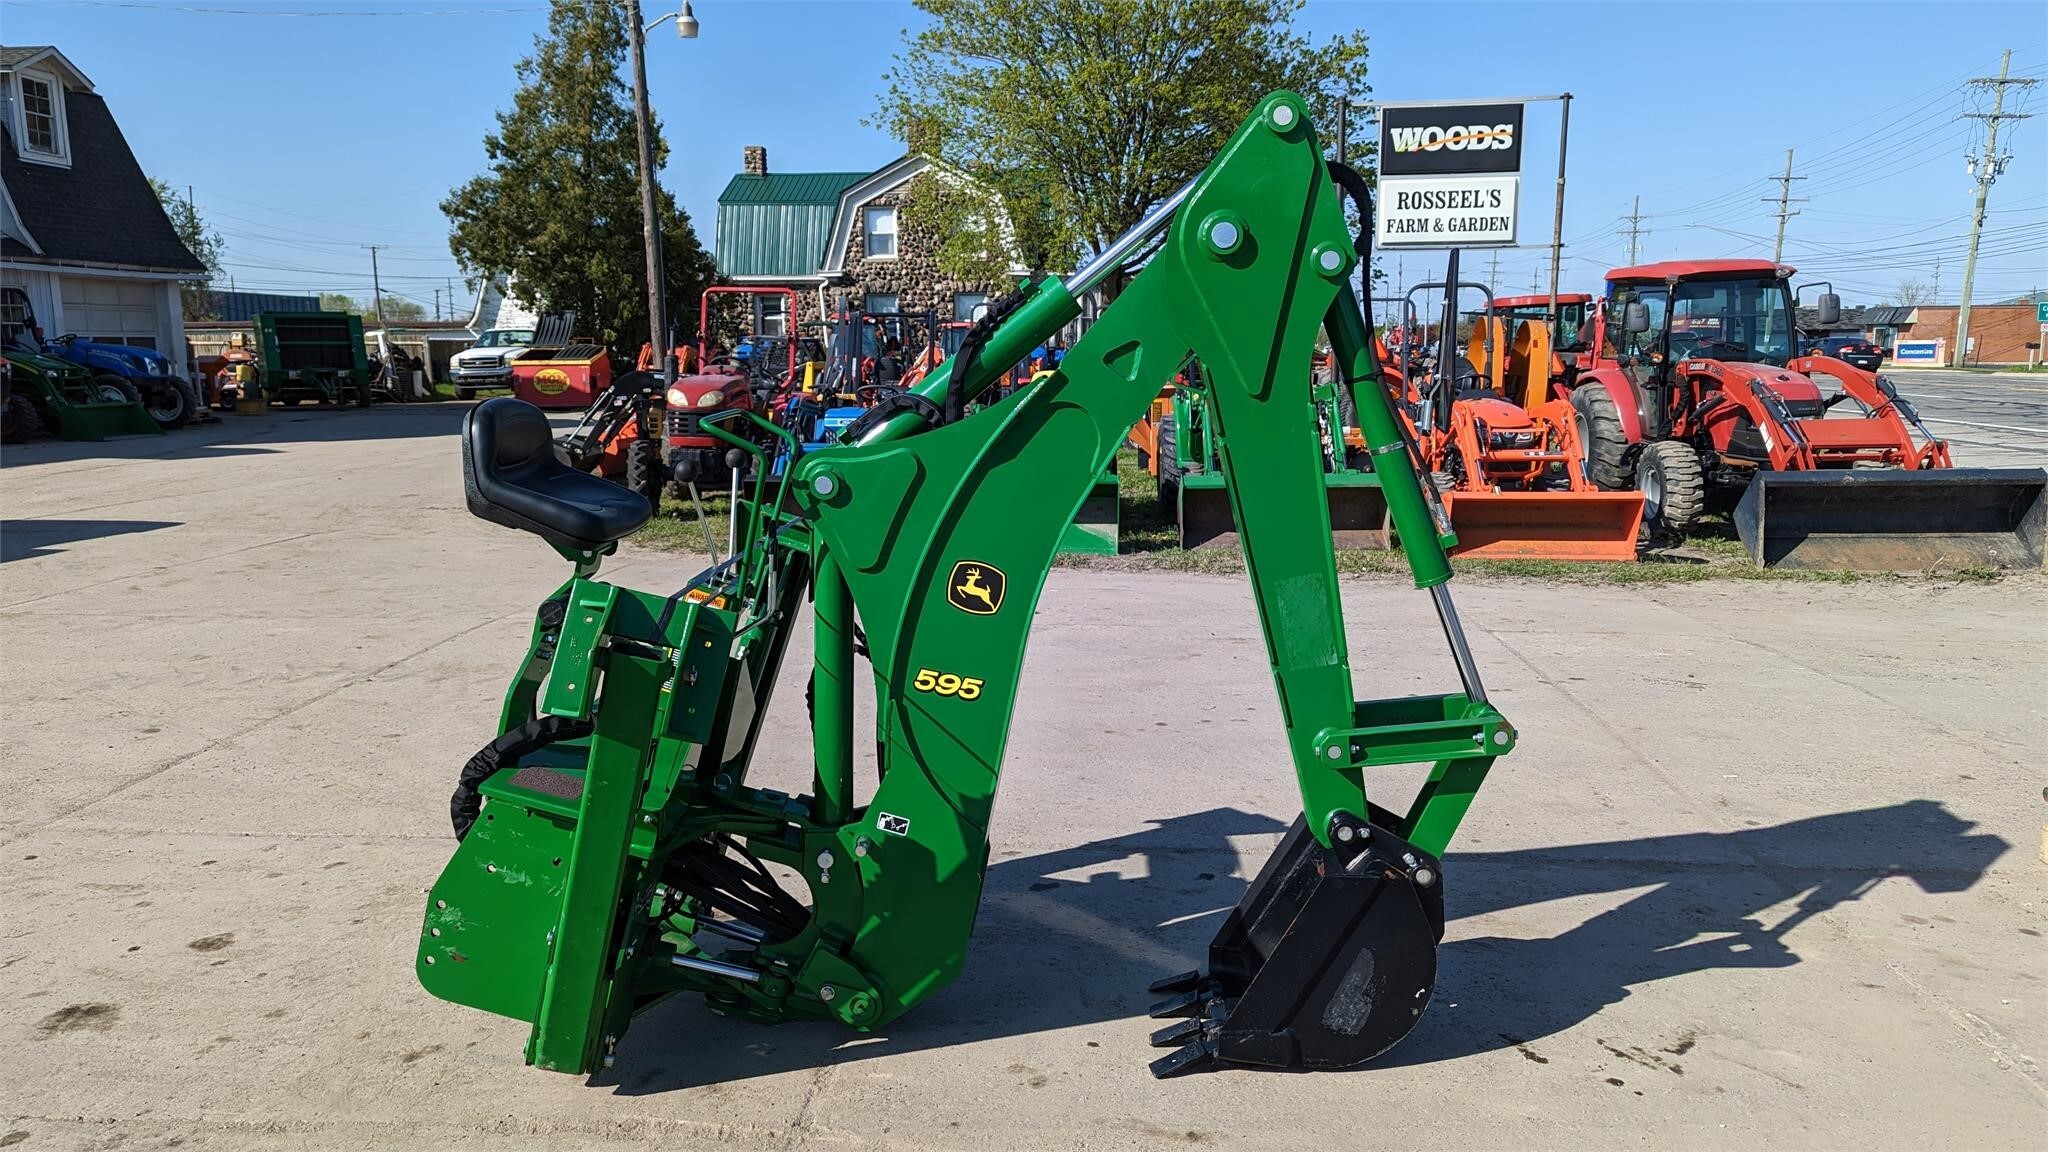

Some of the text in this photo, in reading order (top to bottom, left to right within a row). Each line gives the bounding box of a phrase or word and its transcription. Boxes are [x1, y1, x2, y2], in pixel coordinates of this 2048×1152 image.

[1390, 124, 1513, 152] WOODS
[1397, 189, 1502, 210] ROSSEEL'S
[1386, 216, 1511, 233] FARM & GARDEN
[913, 668, 984, 700] 595
